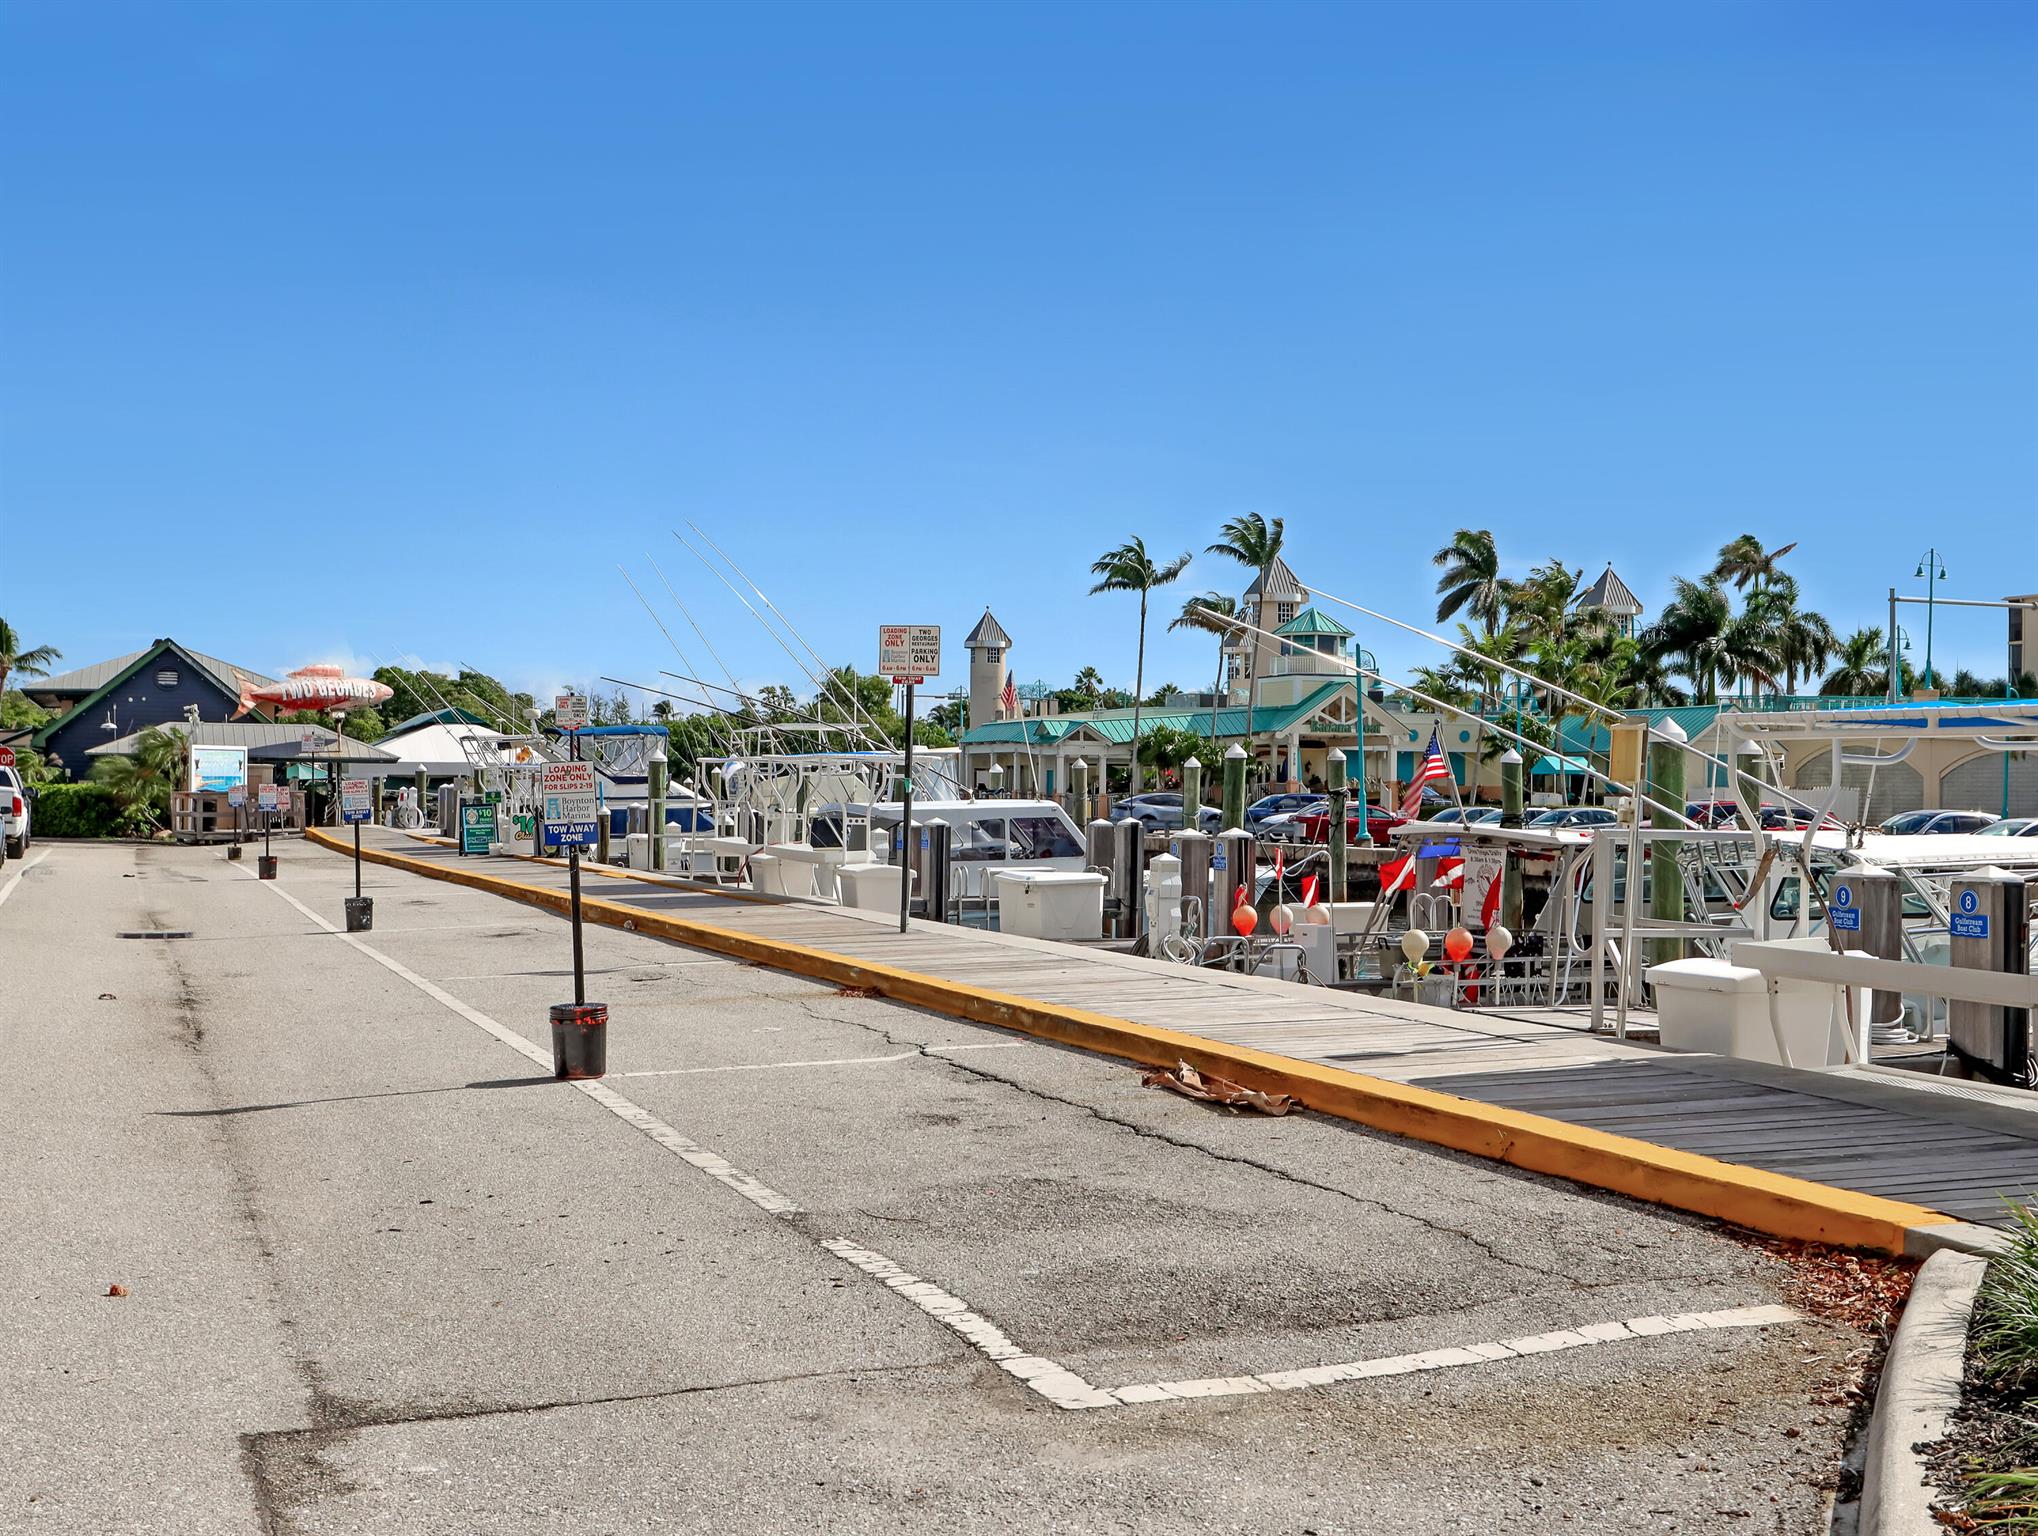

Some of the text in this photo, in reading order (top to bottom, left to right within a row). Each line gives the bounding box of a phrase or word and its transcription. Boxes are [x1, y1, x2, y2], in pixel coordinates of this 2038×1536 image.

[913, 655, 936, 663] ONLY
[281, 679, 376, 700] TWO GEORGES
[0, 754, 13, 764] OP
[548, 764, 587, 774] LOADING
[544, 773, 593, 782] ZONE ONLY
[562, 797, 594, 806] Boynton
[562, 804, 590, 812] Harbor
[548, 824, 595, 834] TOW AWAY
[561, 833, 584, 842] ZONE
[1841, 890, 1845, 903] 9
[1966, 896, 1971, 909] 8
[1955, 917, 1983, 925] Gulfstream
